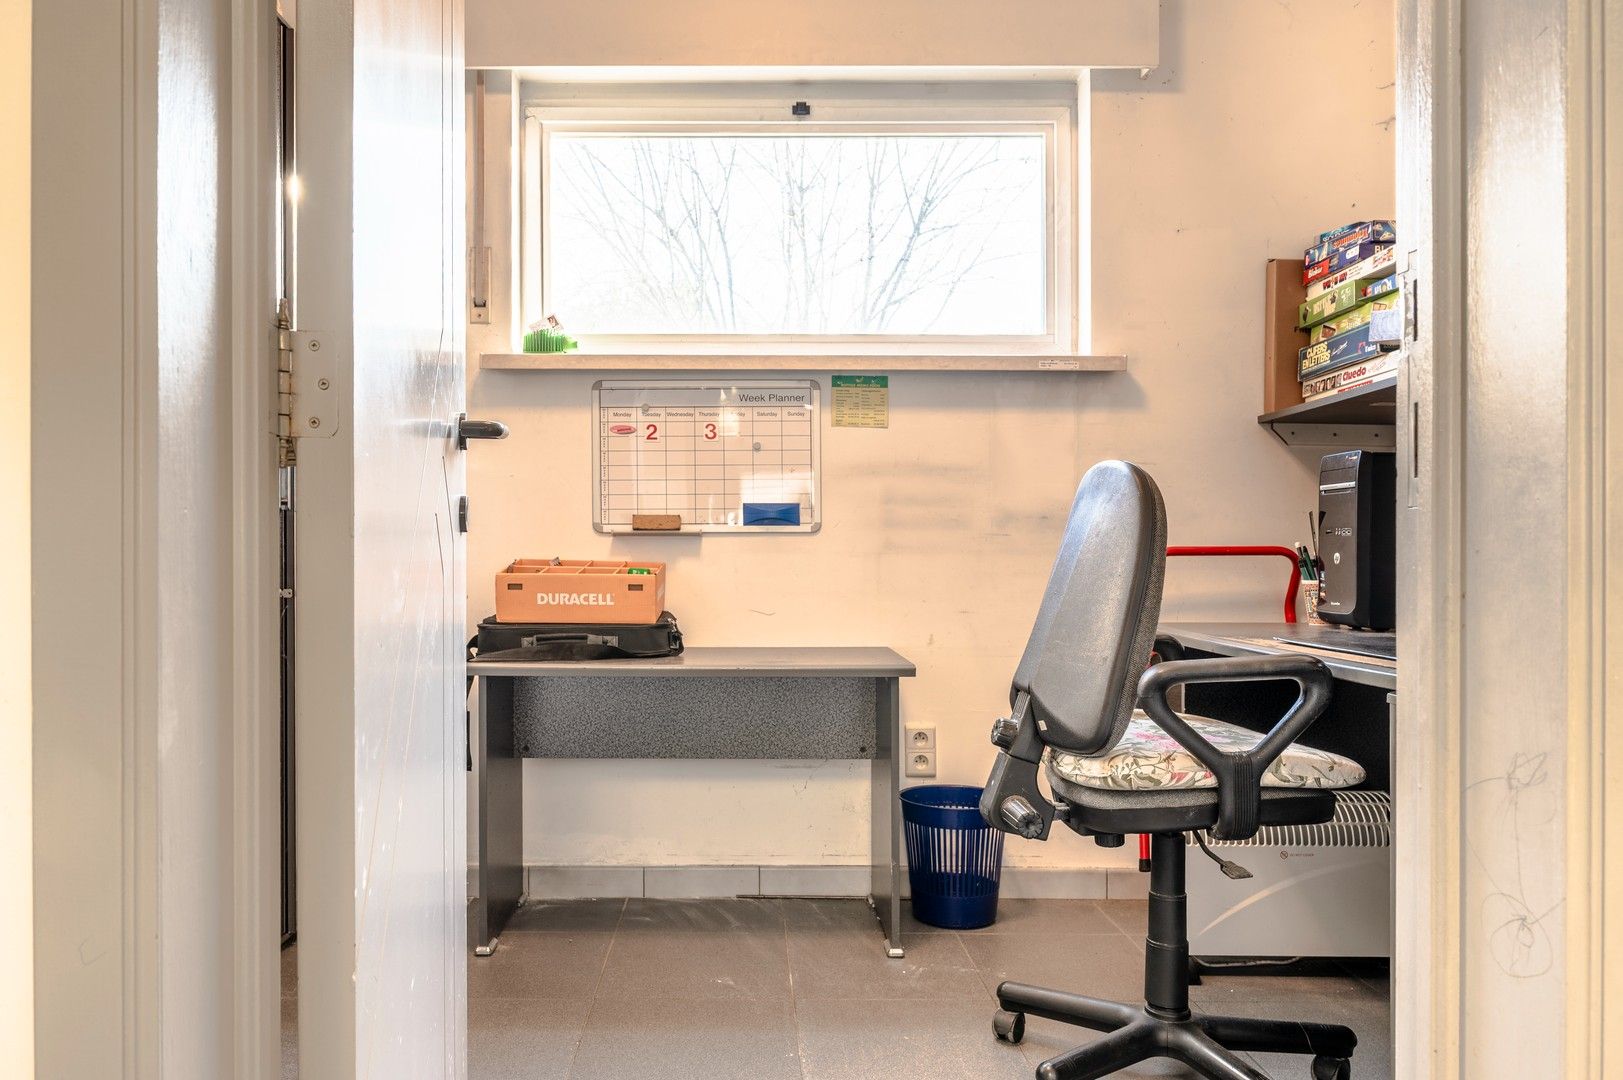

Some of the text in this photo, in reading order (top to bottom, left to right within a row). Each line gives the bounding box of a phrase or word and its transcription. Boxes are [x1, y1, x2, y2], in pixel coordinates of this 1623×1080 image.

[1310, 352, 1330, 367] LETTERS
[1342, 367, 1367, 382] Cluedo
[738, 393, 805, 402] Week Planner
[646, 423, 717, 440] 2 3
[536, 592, 614, 606] DURACELL
